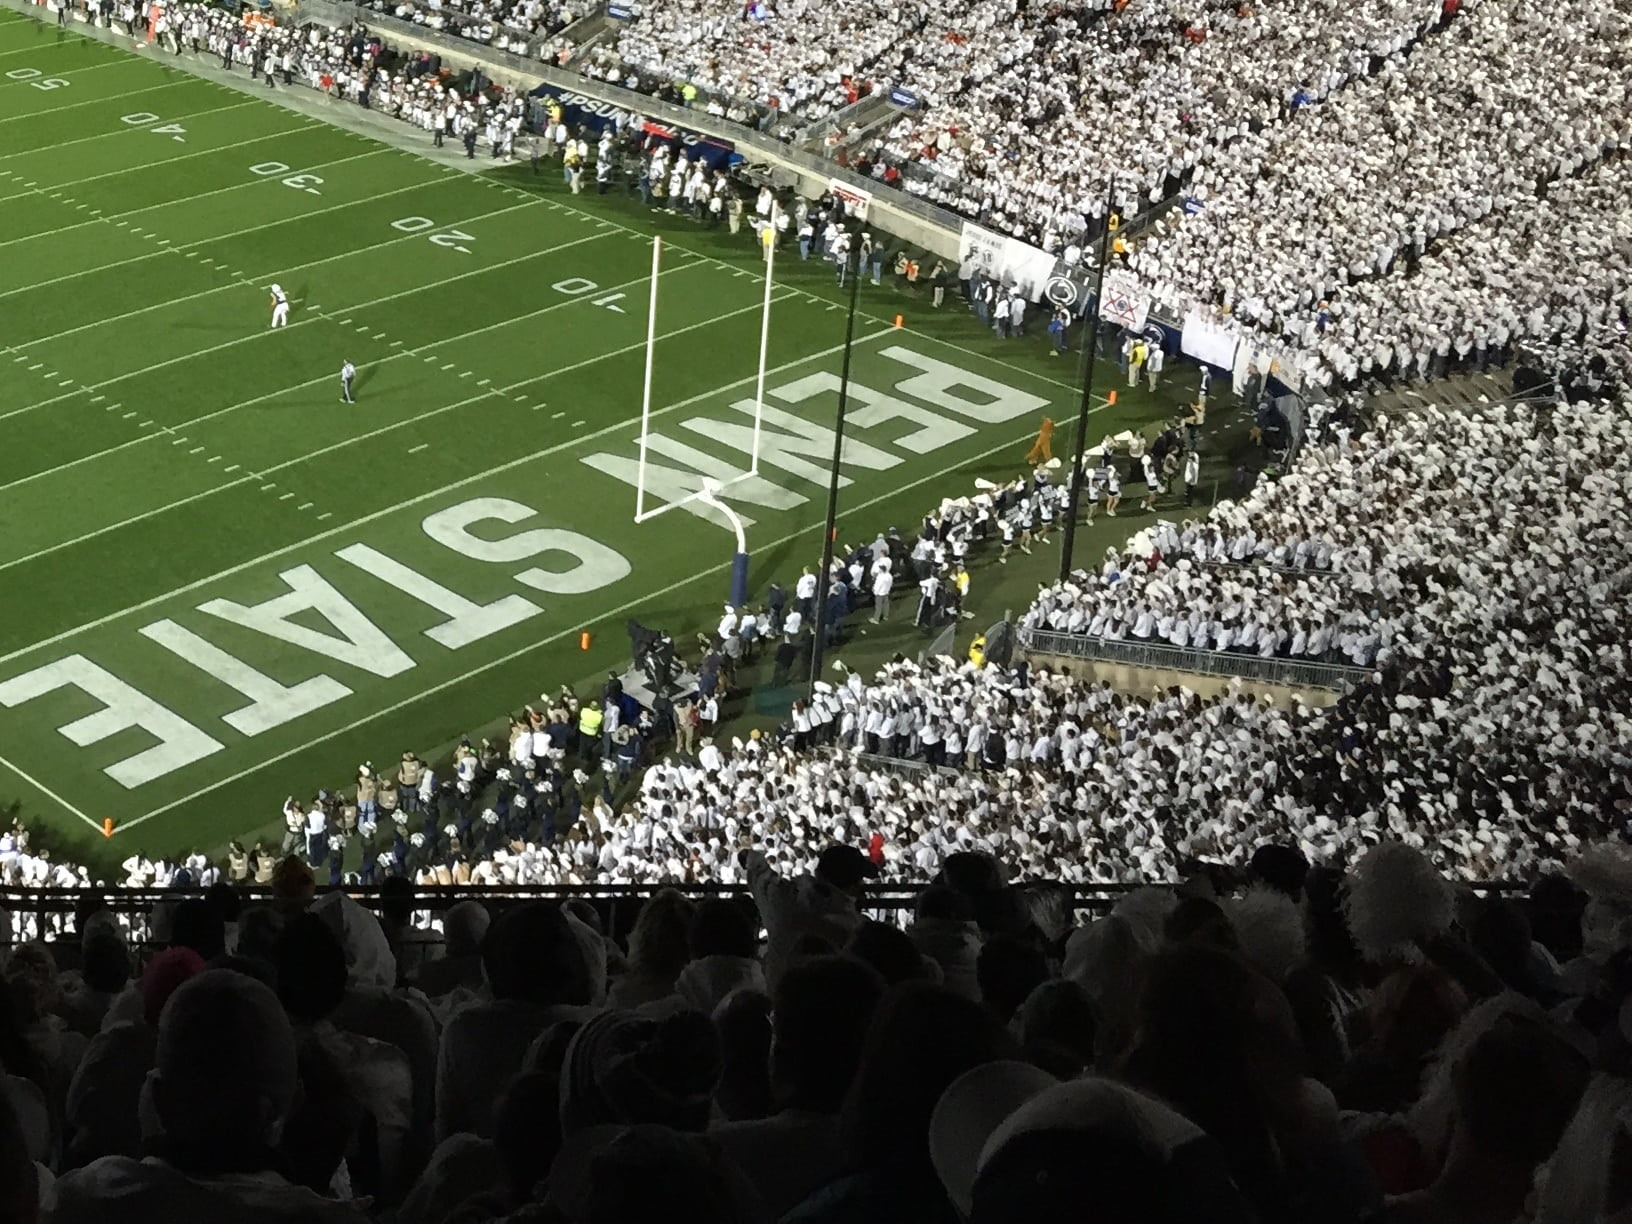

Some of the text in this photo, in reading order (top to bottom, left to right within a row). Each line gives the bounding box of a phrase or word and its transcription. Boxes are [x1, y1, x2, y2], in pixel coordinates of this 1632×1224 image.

[5, 67, 70, 92] 50
[120, 112, 186, 137] 40
[249, 161, 324, 188] 30
[390, 216, 475, 249] 20
[551, 277, 626, 309] 10
[578, 345, 1051, 528] PENN
